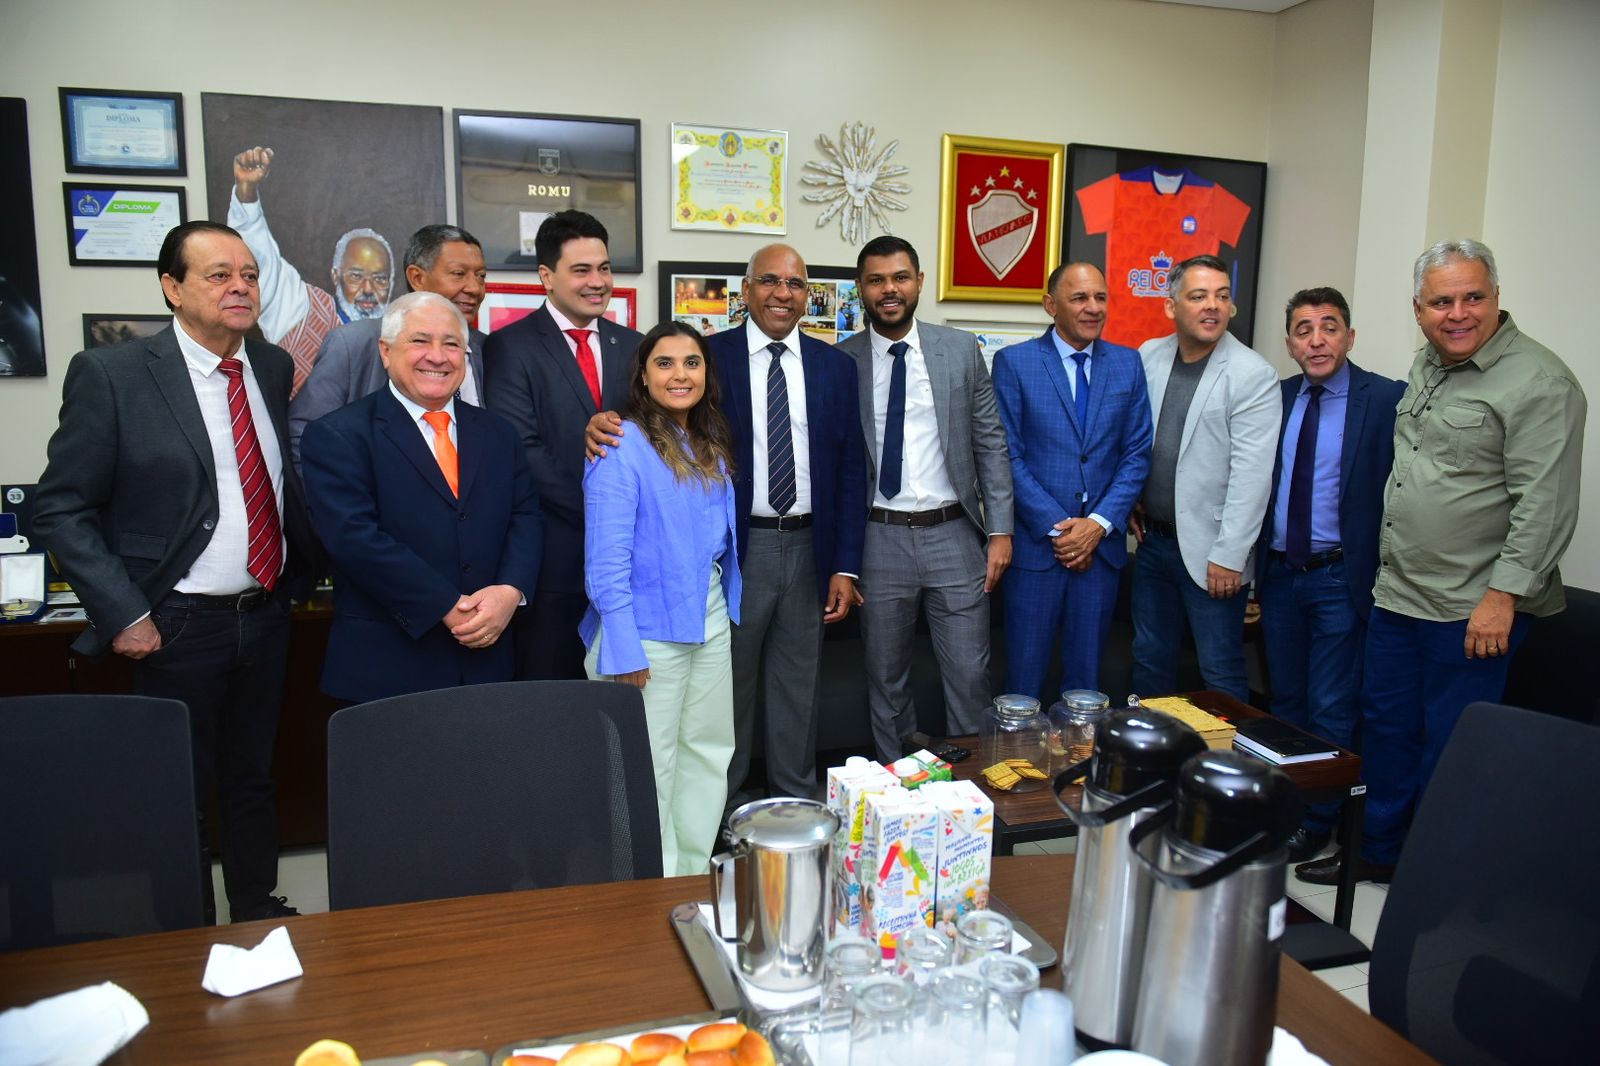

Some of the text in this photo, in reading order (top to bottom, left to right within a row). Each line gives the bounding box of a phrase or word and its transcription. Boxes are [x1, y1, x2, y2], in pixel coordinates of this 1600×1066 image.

[105, 114, 141, 122] DIPLOMA
[528, 184, 571, 197] ROMU
[112, 203, 154, 211] DIPLOMA
[1128, 269, 1152, 288] REI
[9, 493, 22, 501] 33
[942, 841, 988, 869] JUNTINHOS
